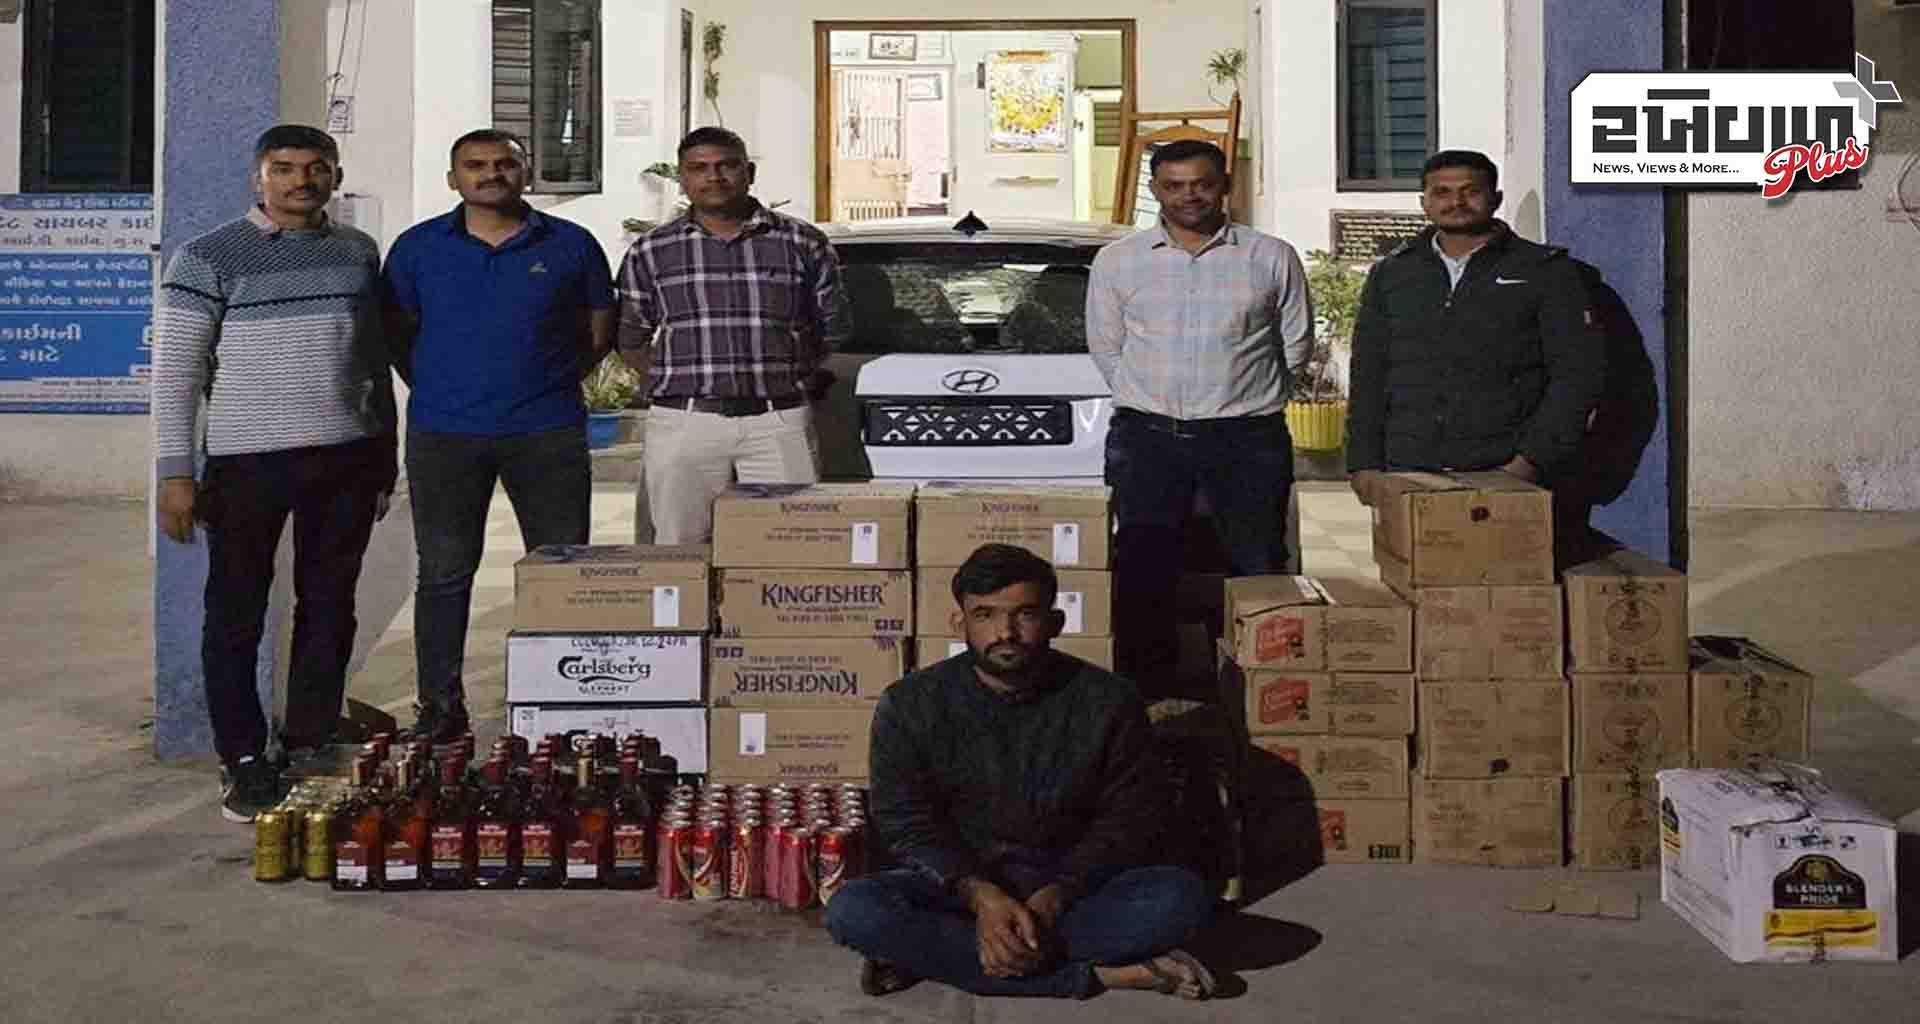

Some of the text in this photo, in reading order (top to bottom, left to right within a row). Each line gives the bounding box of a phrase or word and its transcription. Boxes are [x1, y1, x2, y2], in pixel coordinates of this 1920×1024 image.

[761, 583, 886, 608] KINGFISHER
[558, 656, 651, 680] Carlsberg
[734, 671, 858, 696] KINGFISHER
